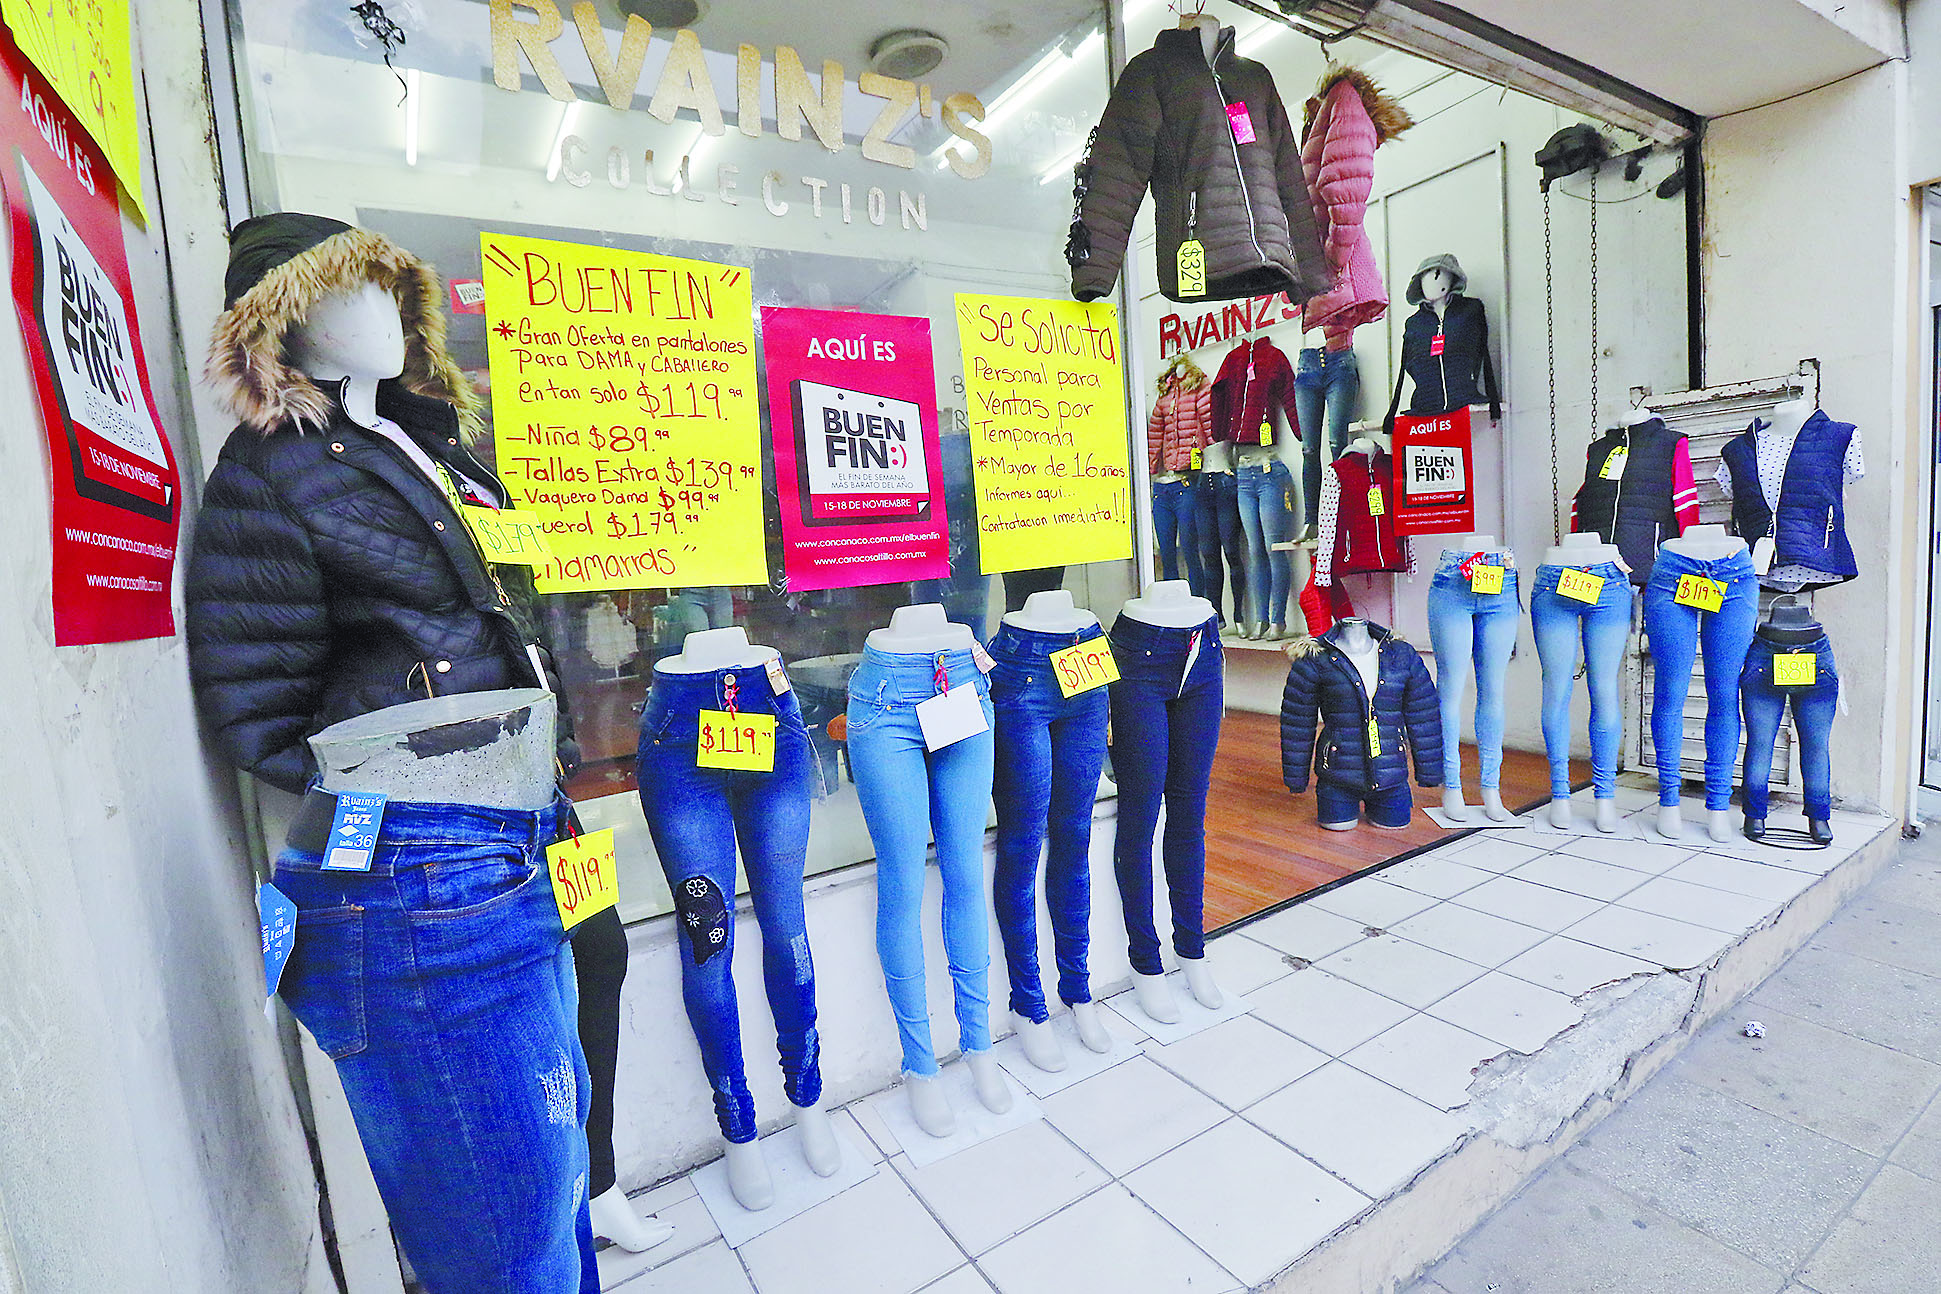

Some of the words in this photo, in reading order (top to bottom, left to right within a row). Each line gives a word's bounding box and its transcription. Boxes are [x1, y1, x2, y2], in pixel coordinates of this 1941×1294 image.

[489, 0, 992, 179] RVAINZ'S
[21, 73, 72, 169] AQUÍ
[74, 141, 95, 196] ES
[561, 134, 928, 231] COLLECTION
[53, 234, 123, 361] BUEN
[632, 334, 650, 349] en
[657, 329, 748, 356] pantalones
[807, 334, 867, 361] AQUÍ
[873, 341, 897, 362] ES
[577, 350, 633, 370] DAMA
[974, 357, 1048, 384] Personal
[1058, 371, 1101, 390] para
[977, 389, 1050, 418] Ventas
[1058, 400, 1094, 428] por
[823, 407, 906, 441] BUEN
[975, 420, 1073, 450] Temporada
[1409, 419, 1437, 435] AQUÍ
[1440, 420, 1452, 431] ES
[595, 458, 660, 483] Extra
[1044, 455, 1067, 478] de
[1072, 452, 1098, 478] 16
[1415, 456, 1454, 468] BUEN
[602, 489, 648, 505] Dama
[824, 501, 847, 511] 15-18
[849, 501, 861, 510] DE
[863, 499, 911, 508] NOVIEMBRE
[985, 486, 1032, 501] Informes
[354, 834, 374, 848] 36
